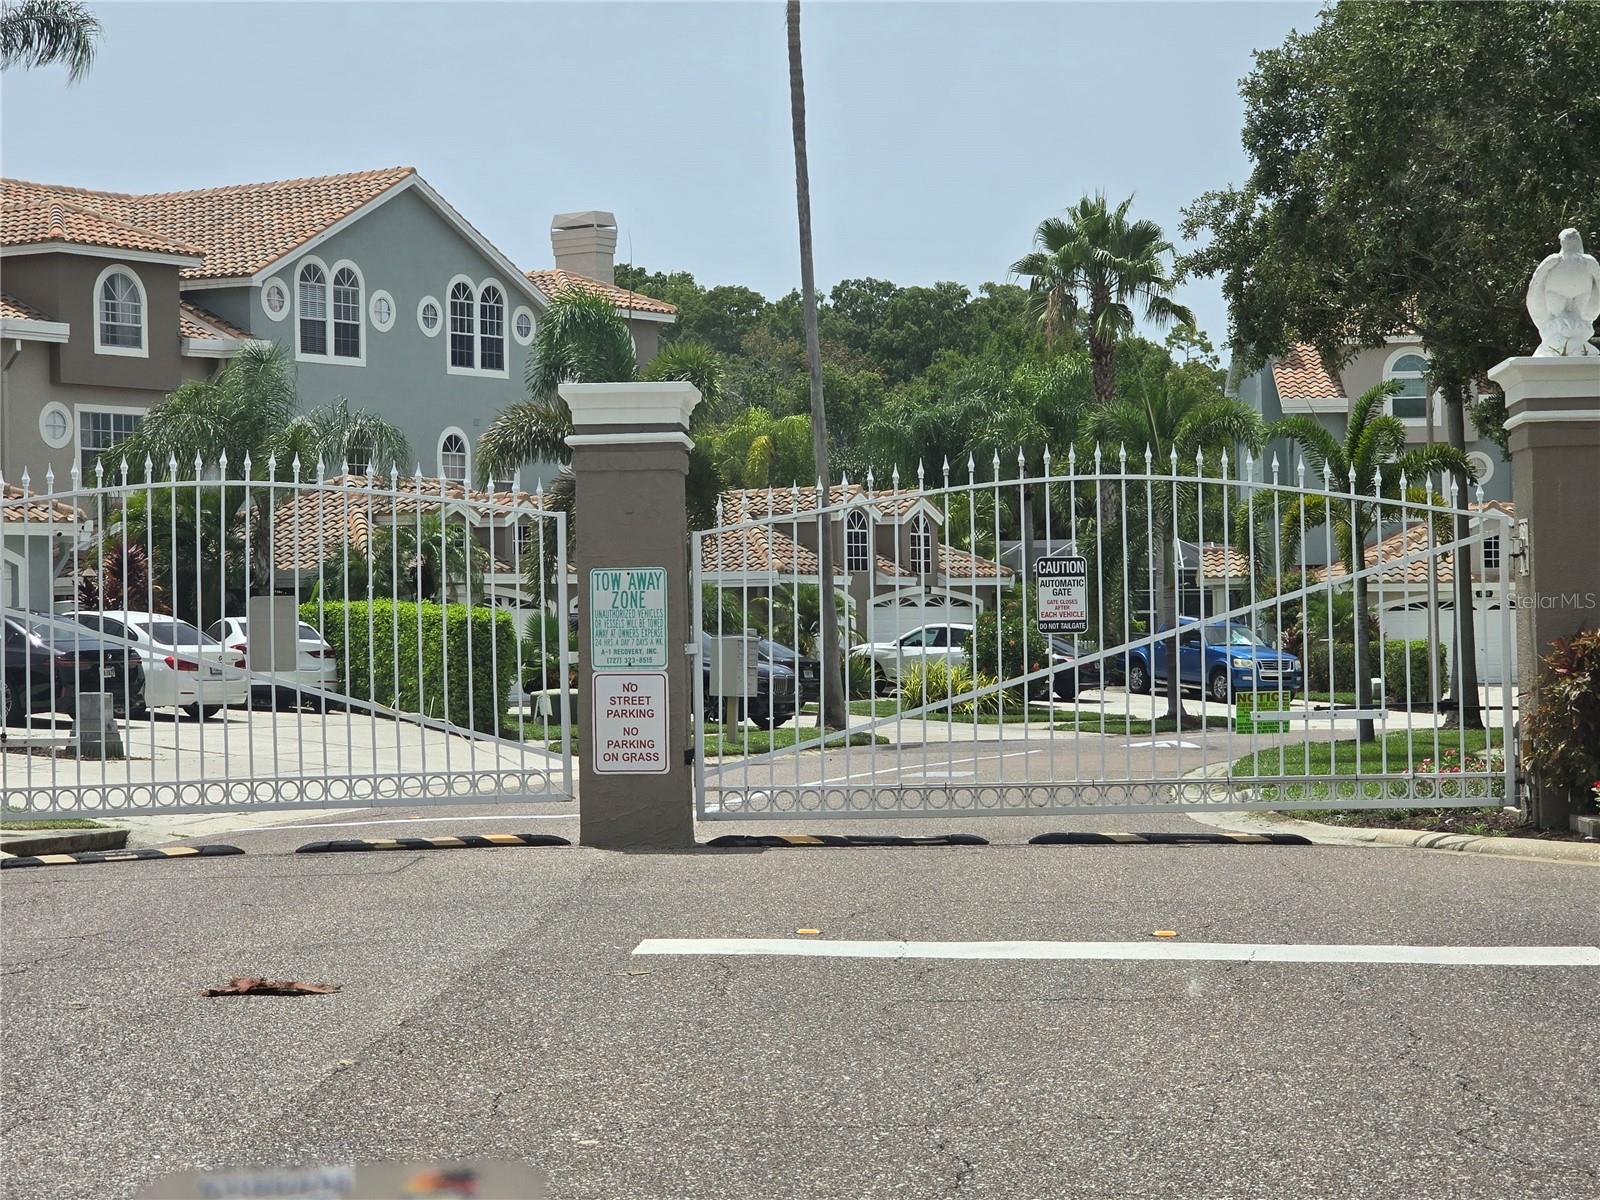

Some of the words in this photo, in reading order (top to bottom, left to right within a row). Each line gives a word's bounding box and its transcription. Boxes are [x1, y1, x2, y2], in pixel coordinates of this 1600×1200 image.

[1038, 560, 1084, 574] CAUTION
[594, 573, 621, 590] TOW
[628, 572, 662, 590] AWAY
[1040, 579, 1084, 588] AUTOMATIC
[1052, 588, 1072, 596] GATE
[612, 591, 645, 609] ZONE
[595, 610, 635, 618] UNAUTHORIZED
[638, 609, 663, 618] VEHICLES
[604, 619, 624, 628] VESSELS
[627, 619, 637, 628] WILL
[639, 619, 646, 628] BE
[647, 618, 663, 628] TOWED
[595, 629, 608, 638] AWAY
[610, 629, 616, 637] AT
[618, 629, 639, 637] OWNERS
[641, 628, 663, 637] EXPENSE
[622, 683, 638, 693] NO
[610, 696, 651, 705] STREET
[607, 709, 654, 718] PARKING
[623, 727, 638, 736] NO
[607, 740, 655, 749] PARKING
[603, 753, 618, 762] ON
[622, 753, 659, 762] GRASS
